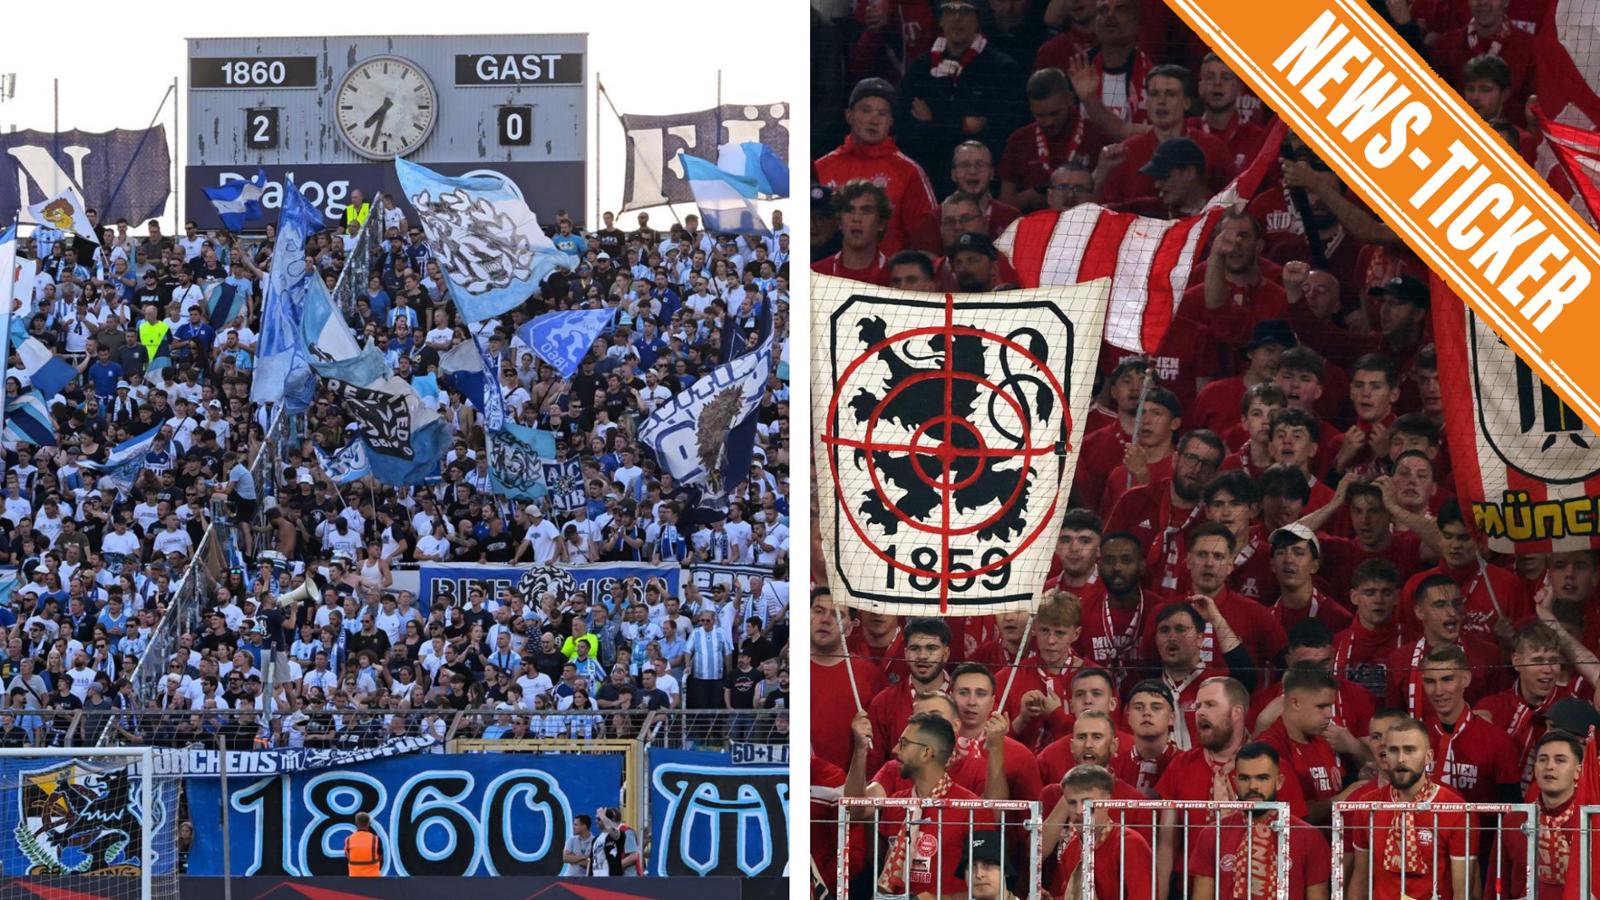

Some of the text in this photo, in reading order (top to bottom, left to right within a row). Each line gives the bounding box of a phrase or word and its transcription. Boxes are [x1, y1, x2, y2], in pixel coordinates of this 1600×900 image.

[221, 61, 286, 85] 1860
[475, 54, 562, 81] GAST
[253, 115, 270, 142] 2
[506, 113, 523, 140] 0
[7, 144, 92, 225] N
[1472, 490, 1600, 541] MÜNC
[884, 544, 1012, 592] 1859
[732, 743, 773, 763] 50+1
[231, 768, 573, 877] 1860
